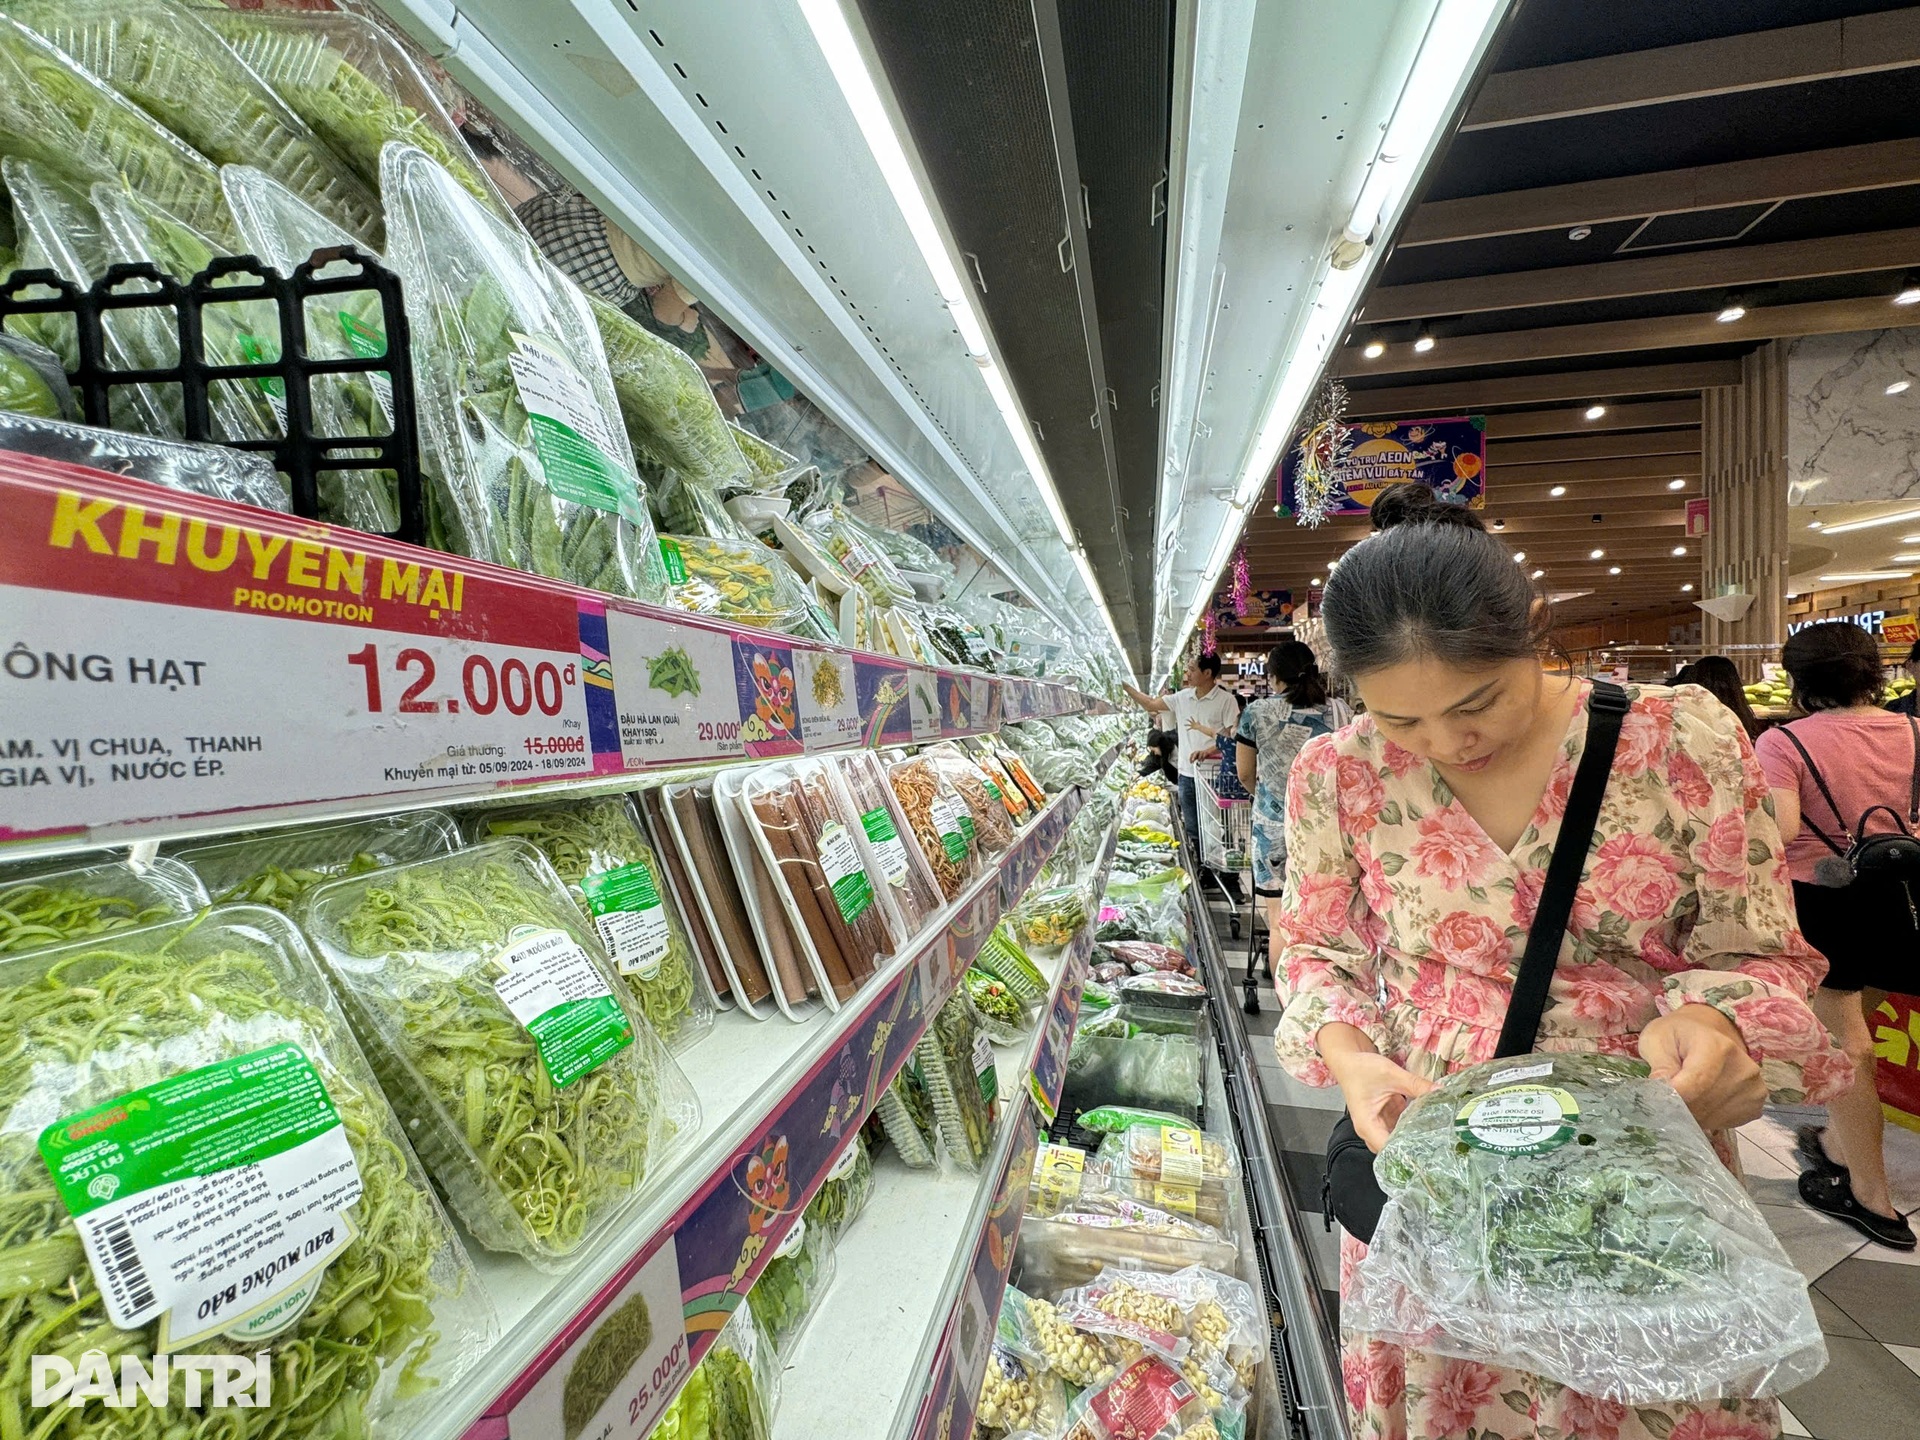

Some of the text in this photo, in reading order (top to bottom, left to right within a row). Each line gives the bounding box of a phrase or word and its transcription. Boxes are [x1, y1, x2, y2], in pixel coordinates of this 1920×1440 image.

[1379, 451, 1412, 463] AEON
[1366, 466, 1387, 479] VUI
[380, 556, 463, 619] MẠI
[234, 586, 374, 623] PROMOTION
[128, 656, 207, 692] HẠT
[347, 642, 576, 717] 12.000đ
[562, 718, 582, 730] /Khay
[621, 712, 680, 726] ĐẬU HÀ LAN (QUẢ)
[698, 720, 741, 741] 29.000đ
[52, 738, 80, 762] VỊ
[89, 737, 173, 757] CHUA,
[185, 736, 262, 754] THANH
[446, 744, 466, 758] Giá
[523, 735, 585, 755] 15.000đ
[0, 766, 51, 787] GIA
[111, 757, 187, 782] NƯỚC
[194, 755, 225, 777] ÉP.
[437, 764, 459, 781] mại
[460, 761, 477, 776] từ:
[479, 760, 533, 774] 05/09/2024
[541, 757, 586, 770] 18/09/2024
[511, 953, 523, 963] RAU
[98, 1144, 119, 1157] ISO
[1518, 1143, 1539, 1151] RAU
[126, 1185, 185, 1215] 10/09/2024
[285, 1187, 299, 1198] 200
[322, 1186, 346, 1201] muống
[286, 1208, 305, 1221] 100%
[198, 1228, 334, 1319] RAU MUỐNG BẢO
[629, 1333, 684, 1425] 25.000đ
